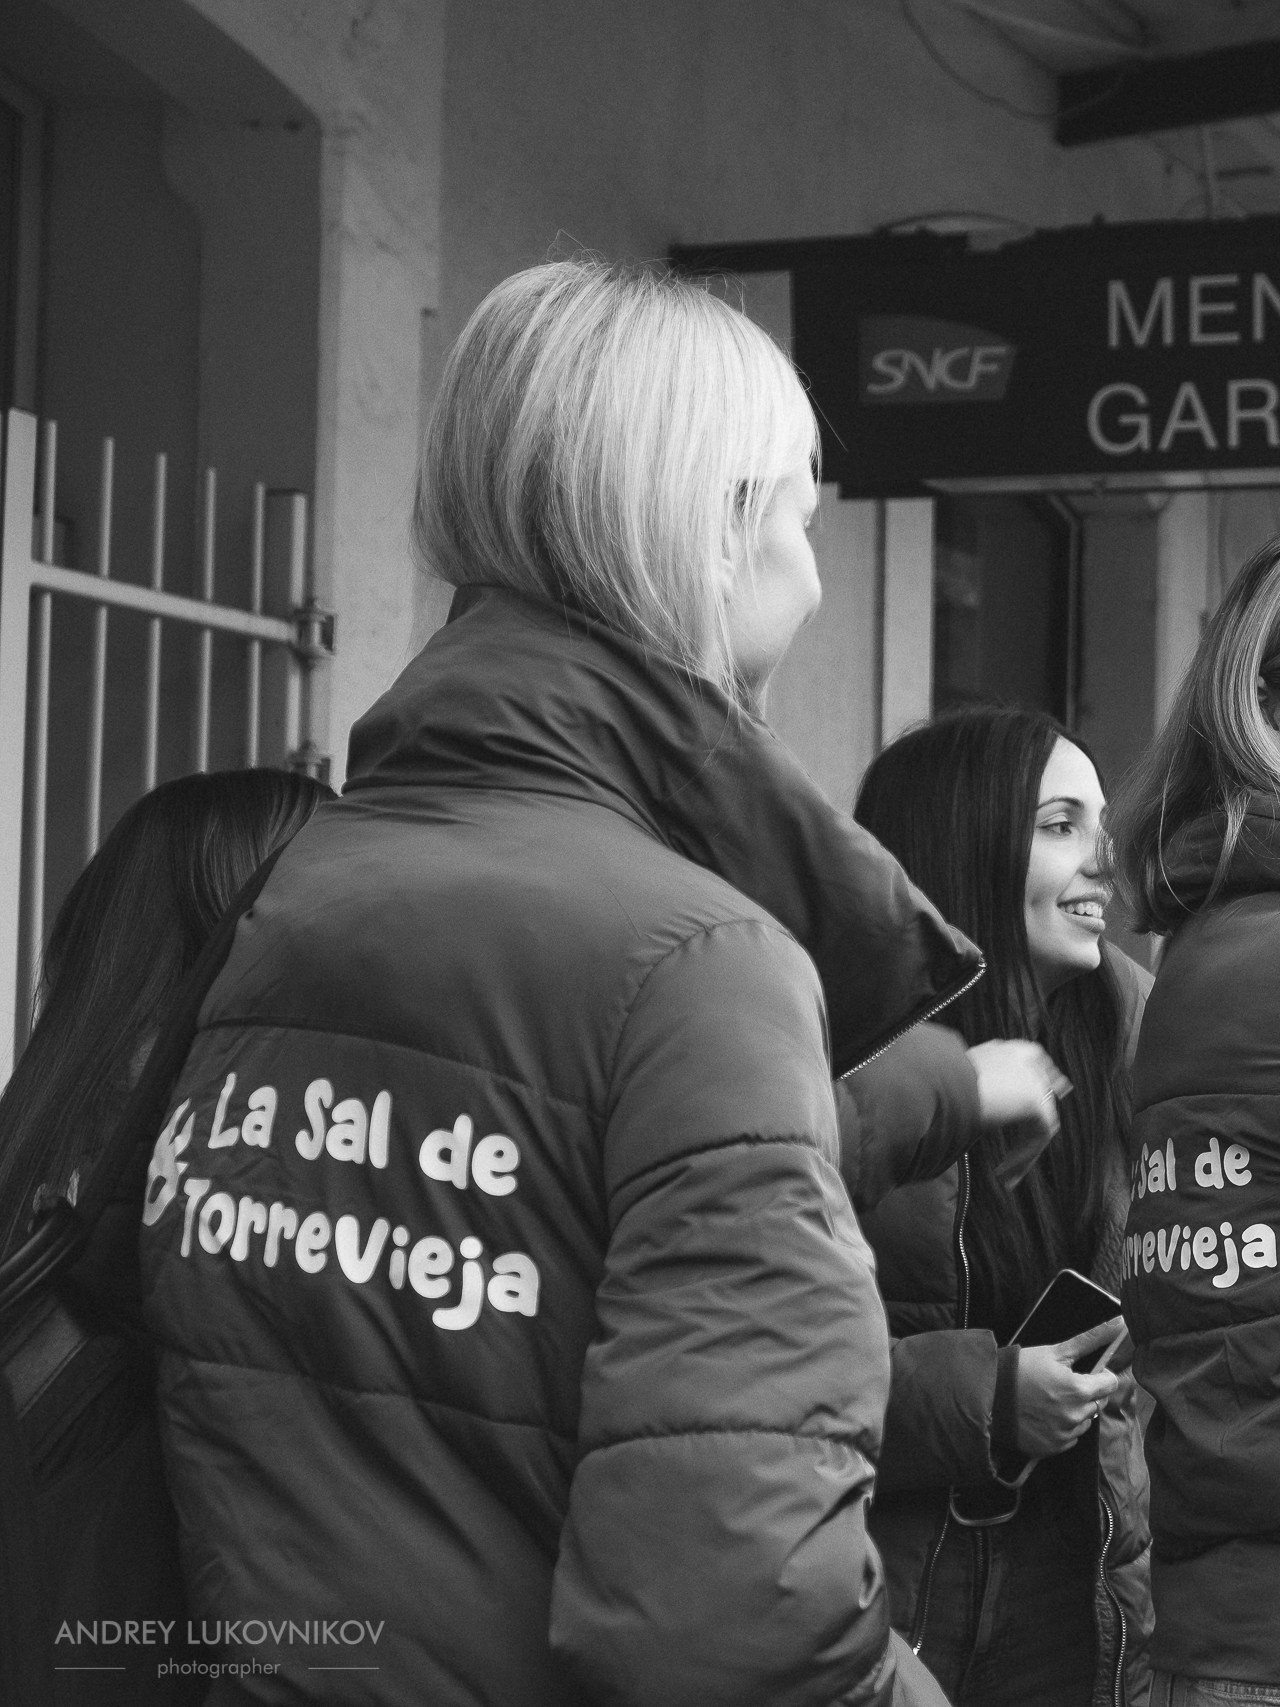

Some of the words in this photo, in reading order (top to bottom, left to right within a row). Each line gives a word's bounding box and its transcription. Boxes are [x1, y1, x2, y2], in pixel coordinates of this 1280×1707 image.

[866, 345, 1008, 395] SNCF
[207, 1071, 278, 1149] La
[294, 1077, 392, 1170] Sal
[418, 1112, 521, 1196] de
[1194, 1136, 1253, 1189] de
